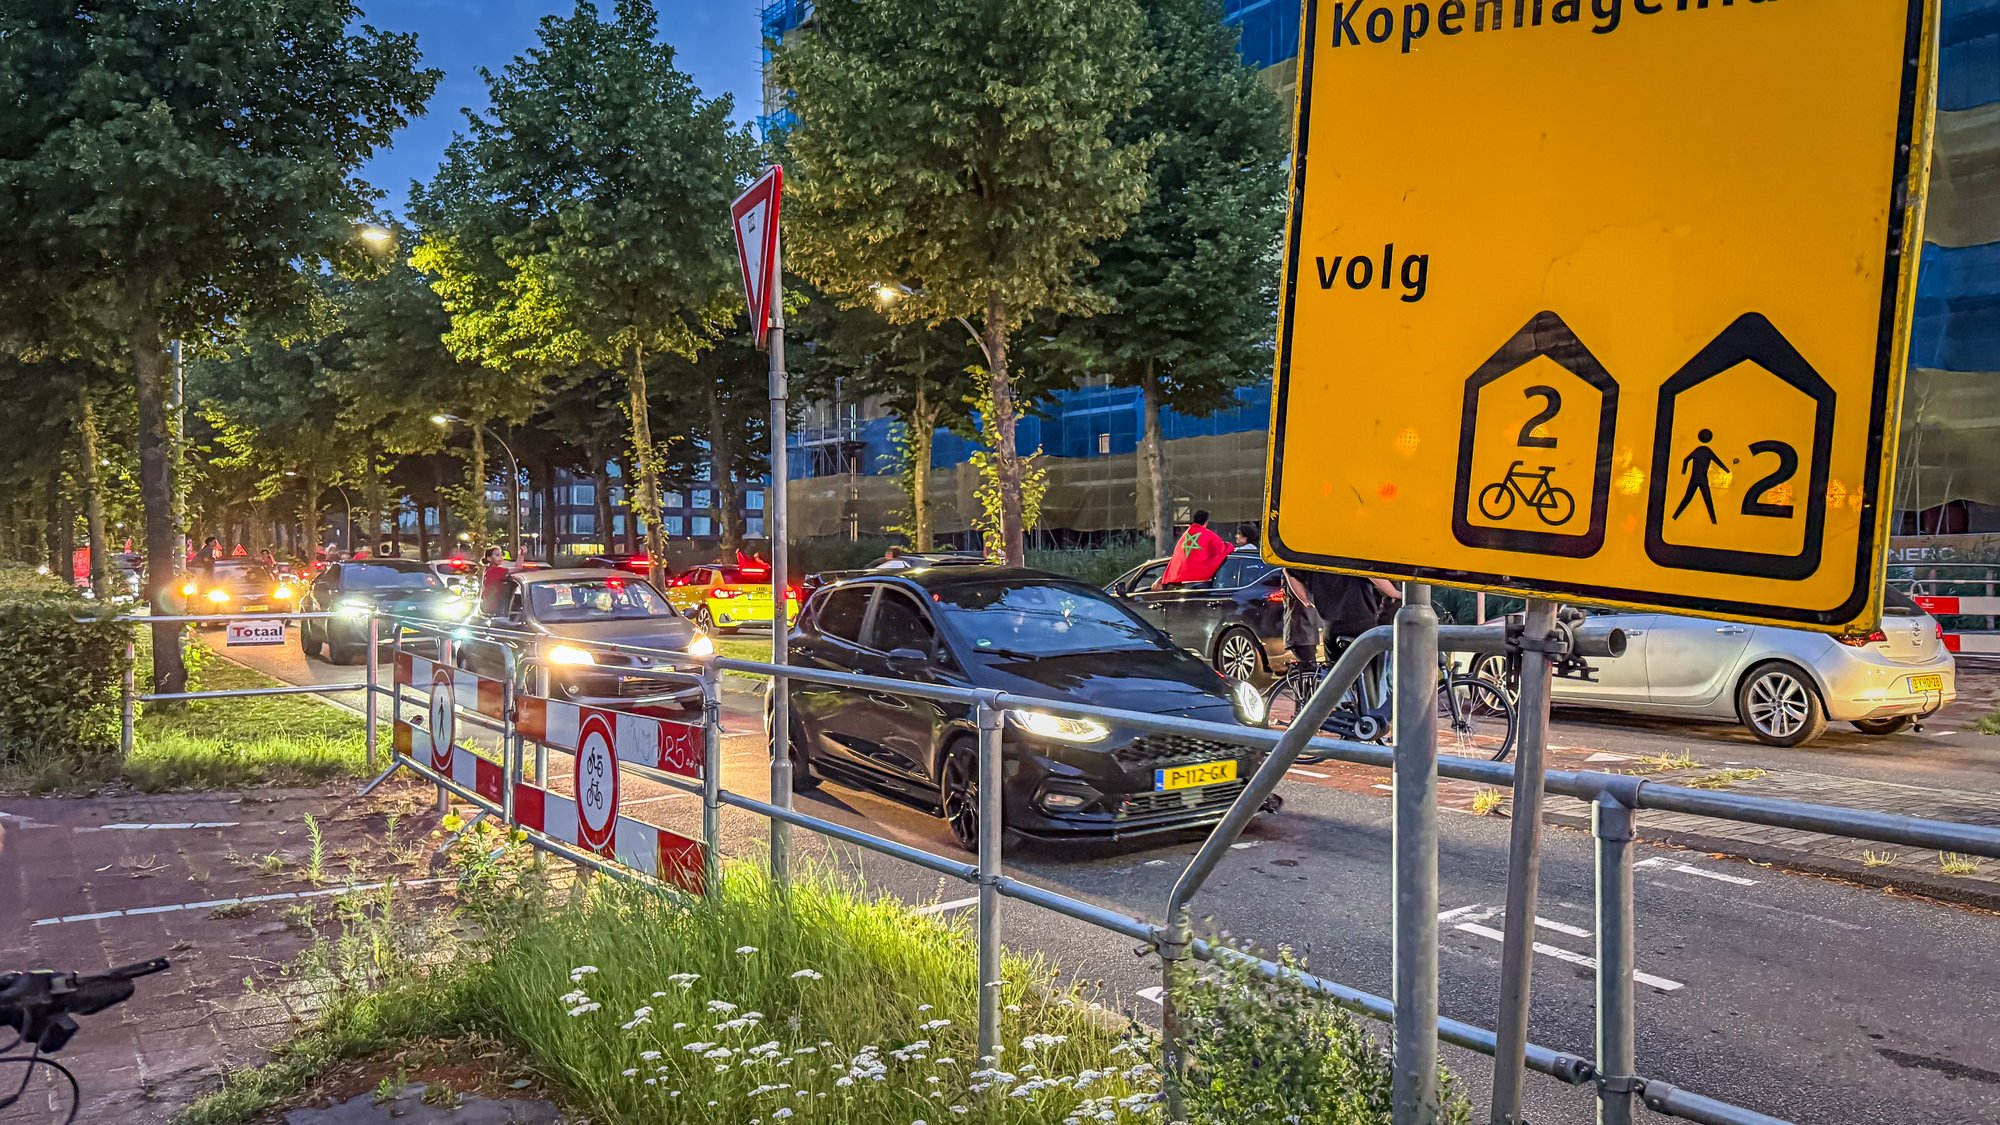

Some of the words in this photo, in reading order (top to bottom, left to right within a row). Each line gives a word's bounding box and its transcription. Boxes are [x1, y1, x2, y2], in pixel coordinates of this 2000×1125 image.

[1315, 243, 1429, 302] volg
[1517, 384, 1562, 448] 2
[1741, 440, 1799, 519] 2
[232, 626, 283, 637] Totaal
[1171, 765, 1228, 785] P-112-GK
